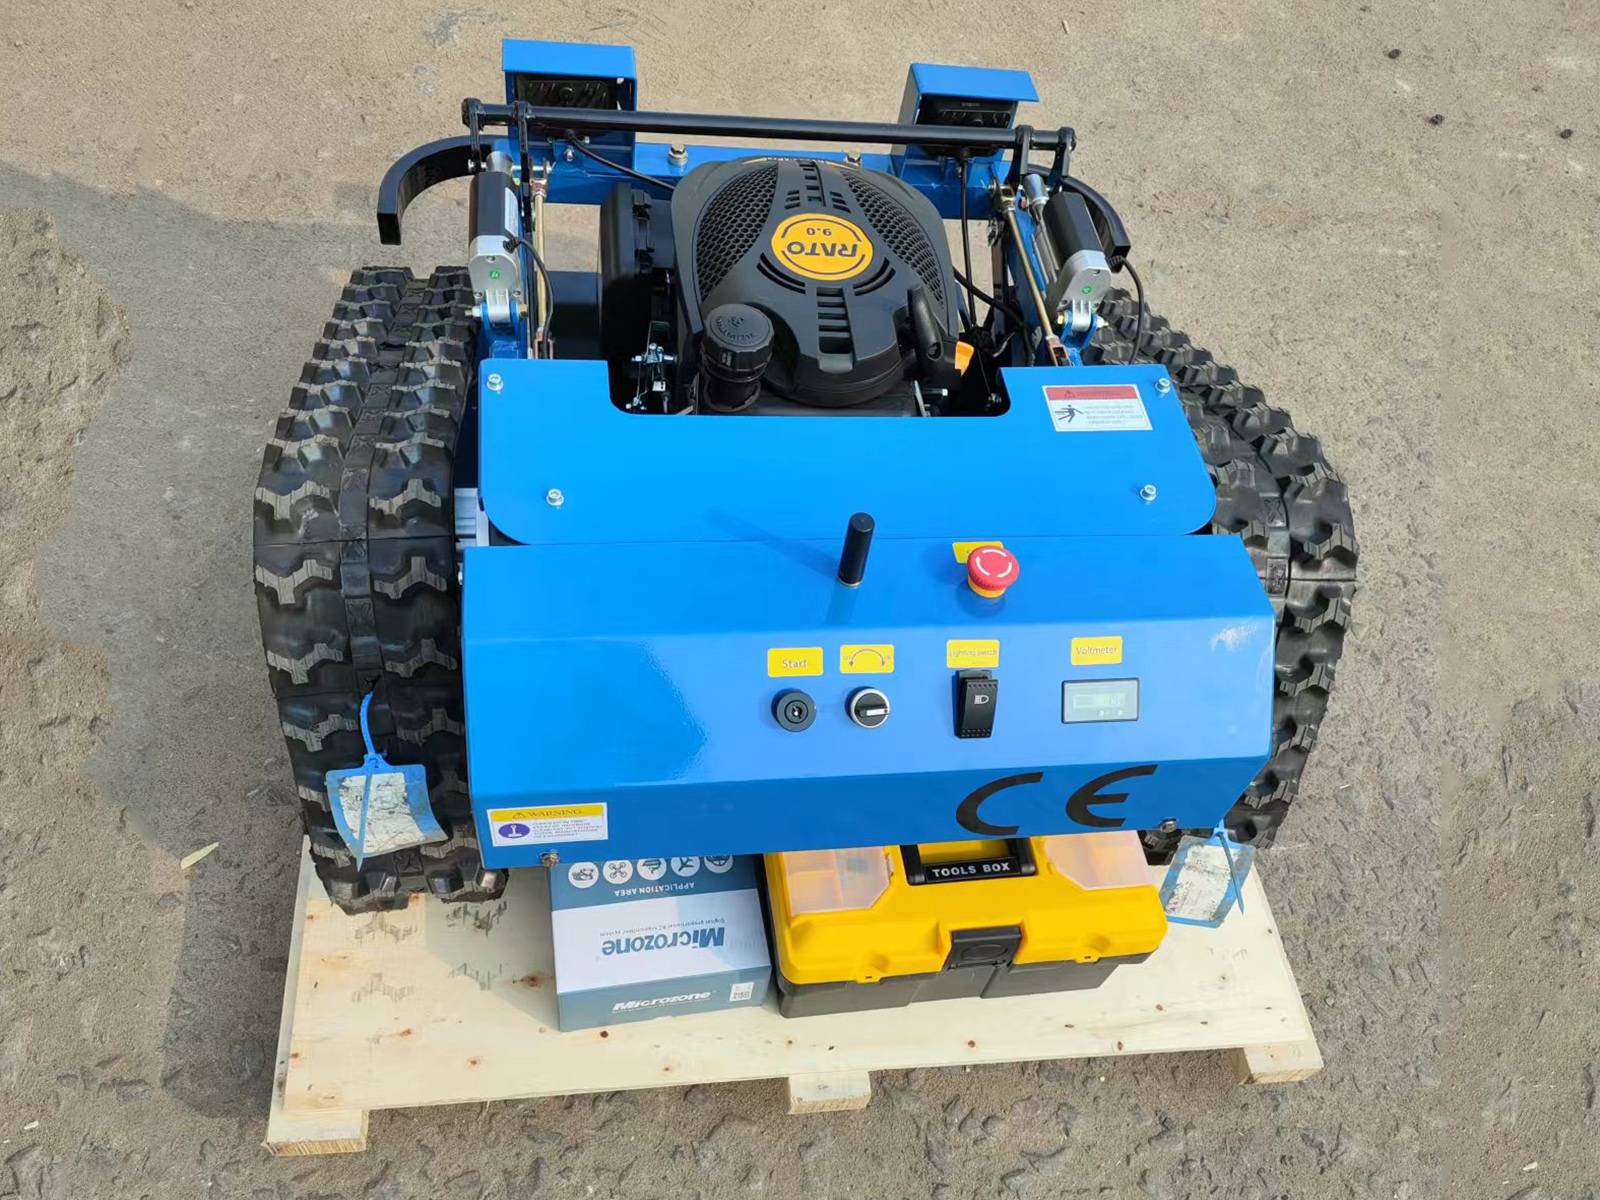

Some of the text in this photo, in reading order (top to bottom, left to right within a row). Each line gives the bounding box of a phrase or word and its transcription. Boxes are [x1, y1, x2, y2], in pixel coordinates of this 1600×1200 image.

[806, 227, 832, 236] 9.0
[786, 241, 858, 257] RATO
[949, 648, 976, 658] Lighting
[1076, 646, 1117, 655] Voltmeter
[782, 659, 807, 668] Start
[956, 764, 1159, 836] CE
[528, 809, 582, 817] WARNING
[932, 862, 1010, 877] TOOLS BOX
[614, 881, 695, 897] APPLICATION AREA
[601, 926, 725, 956] Microzone
[612, 990, 712, 1012] Microzone
